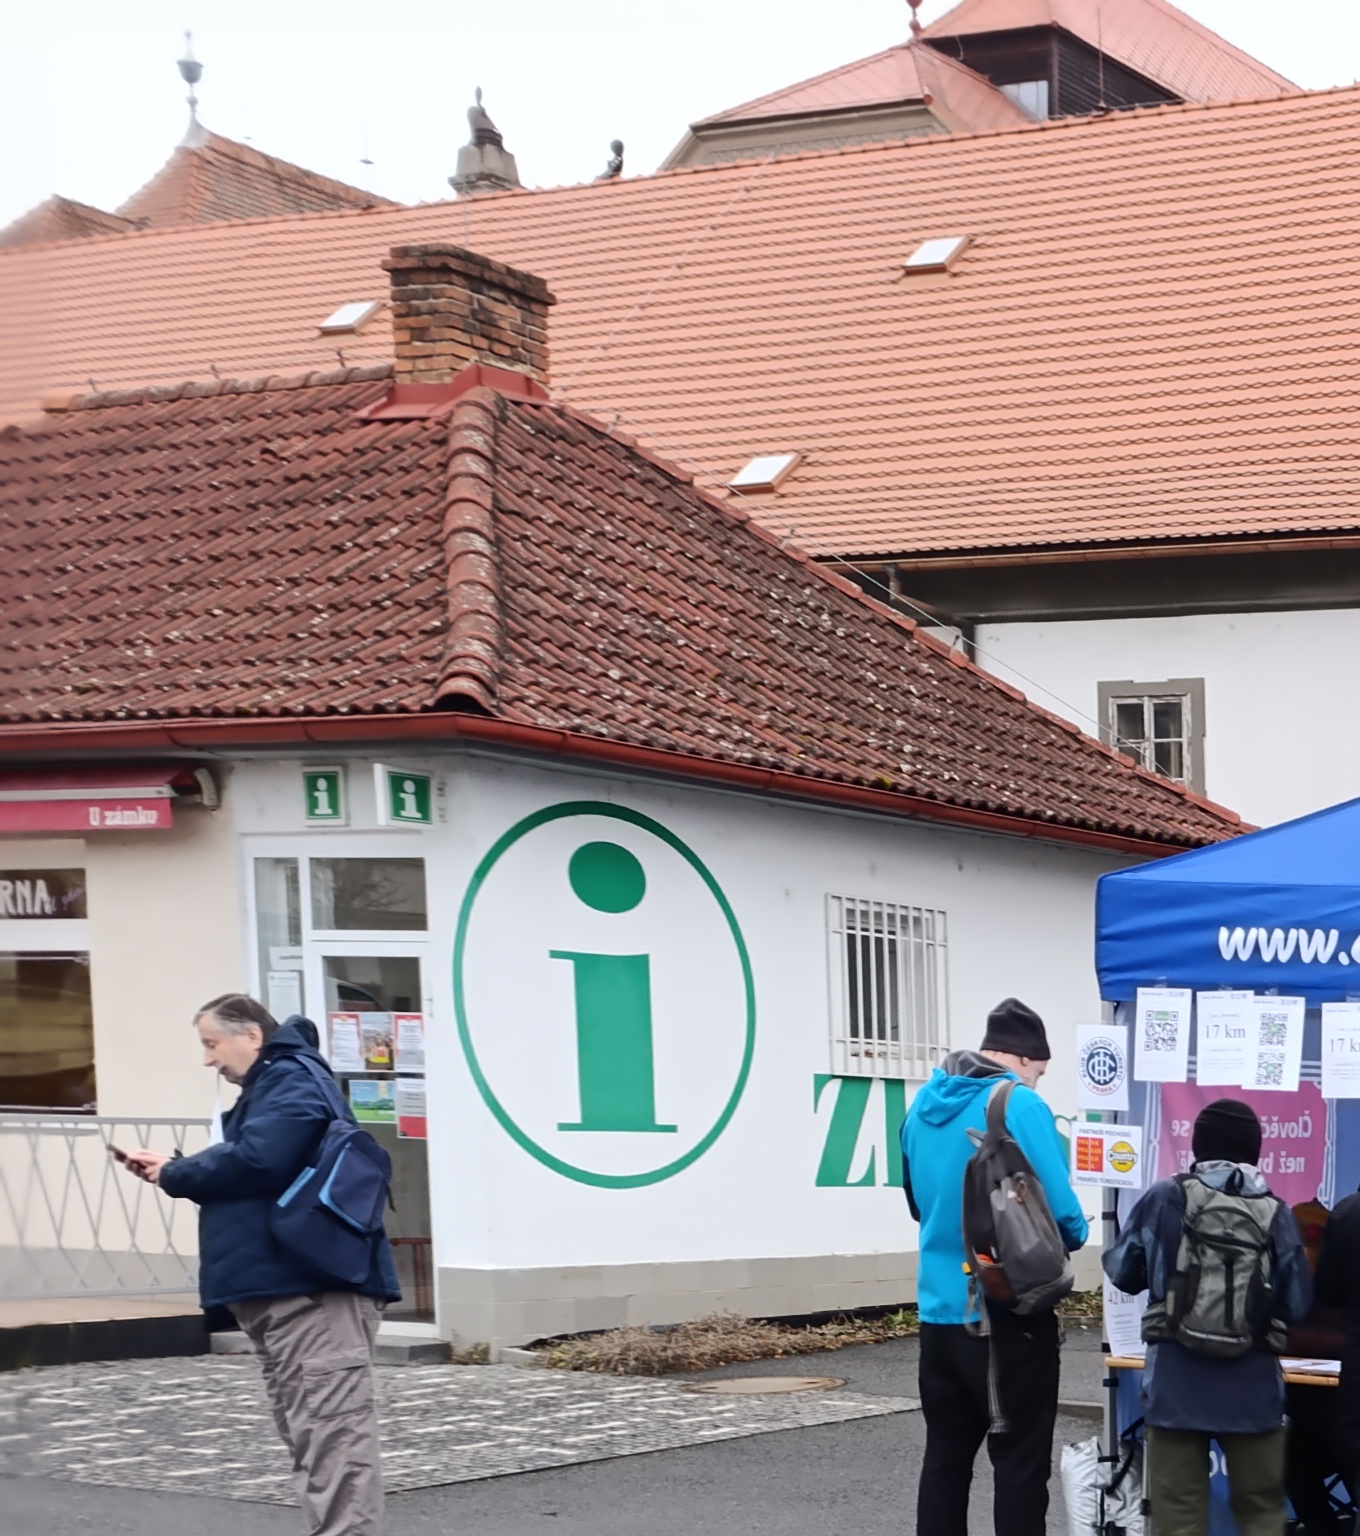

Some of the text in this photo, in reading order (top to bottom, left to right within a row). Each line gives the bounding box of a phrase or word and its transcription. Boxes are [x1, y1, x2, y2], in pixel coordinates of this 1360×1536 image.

[1205, 1024, 1246, 1039] 17 km
[1330, 1038, 1345, 1053] 17
